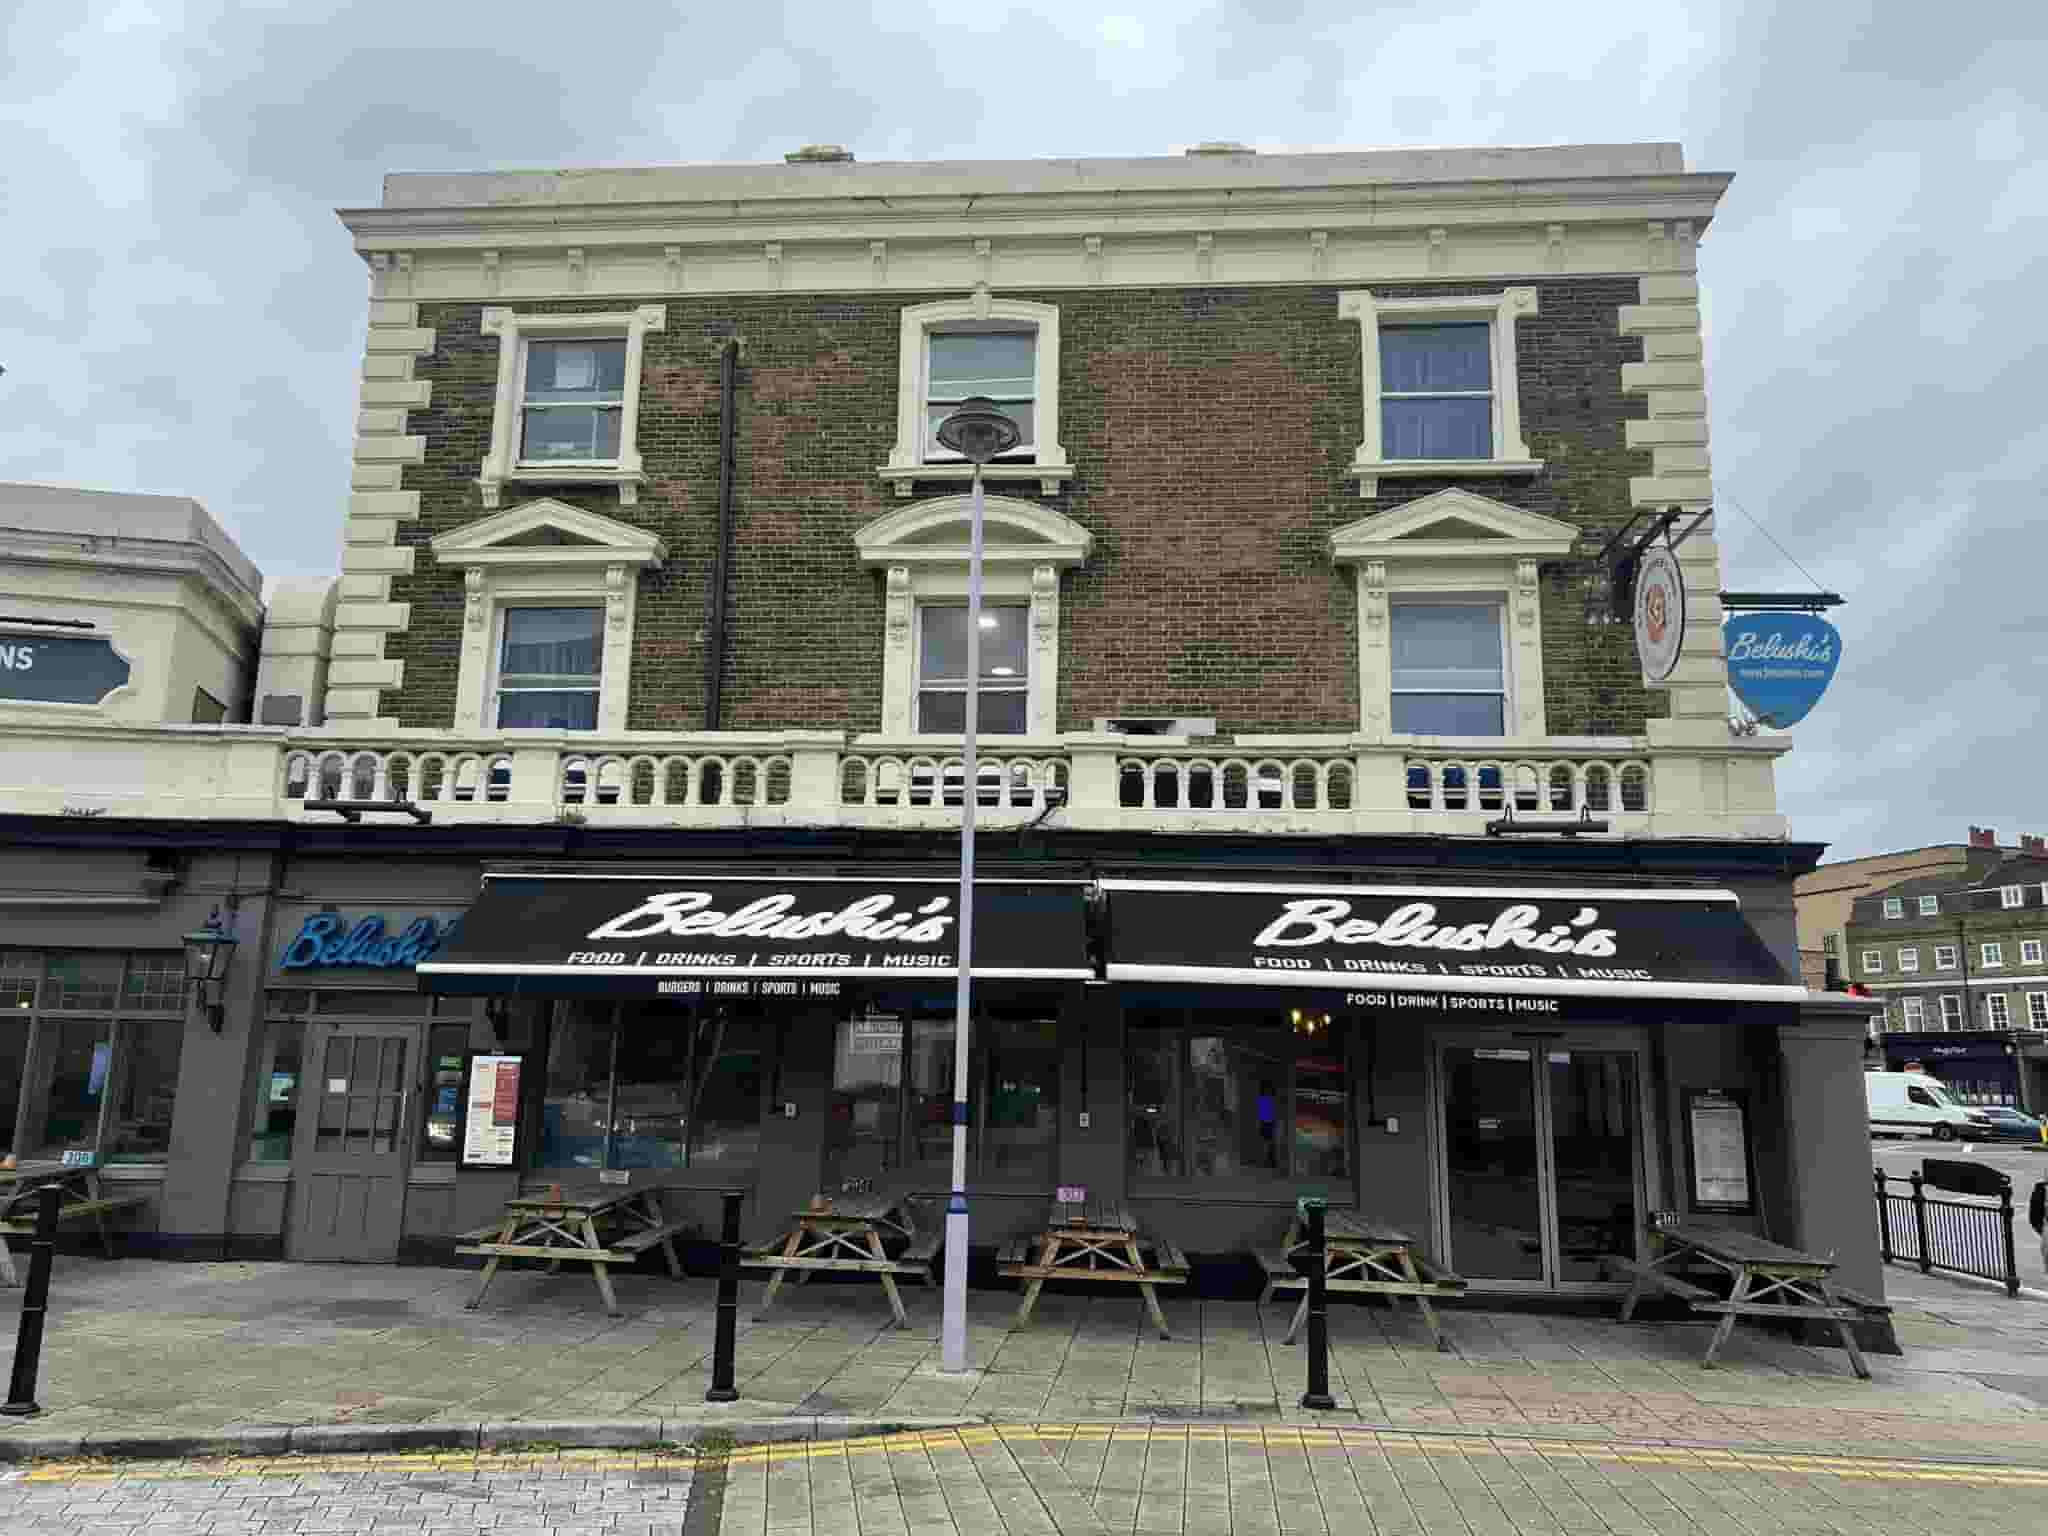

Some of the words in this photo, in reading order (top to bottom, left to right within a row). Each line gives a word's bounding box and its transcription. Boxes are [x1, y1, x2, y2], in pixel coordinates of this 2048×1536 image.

[1728, 632, 1832, 662] Belushi's
[587, 891, 954, 942] Belushi's
[1253, 899, 1617, 957] Belushi's
[279, 912, 457, 969] Belushi'
[567, 952, 626, 965] FOOD
[655, 953, 738, 966] DRINKS
[768, 952, 852, 966] SPORTS
[883, 954, 953, 967] MUSIC
[1253, 956, 1312, 970] FOOD
[1344, 958, 1428, 975] DRINKS
[1458, 963, 1547, 977] SPORTS
[1577, 966, 1654, 981] MUSIC
[713, 981, 750, 993] DRINKS
[760, 981, 798, 994] SPORTS
[810, 982, 841, 995] MUSIC
[1347, 992, 1387, 1006] FOOD
[1398, 994, 1440, 1009] DRINK
[1450, 996, 1506, 1011] SPORTS
[1515, 999, 1560, 1013] MUSIC
